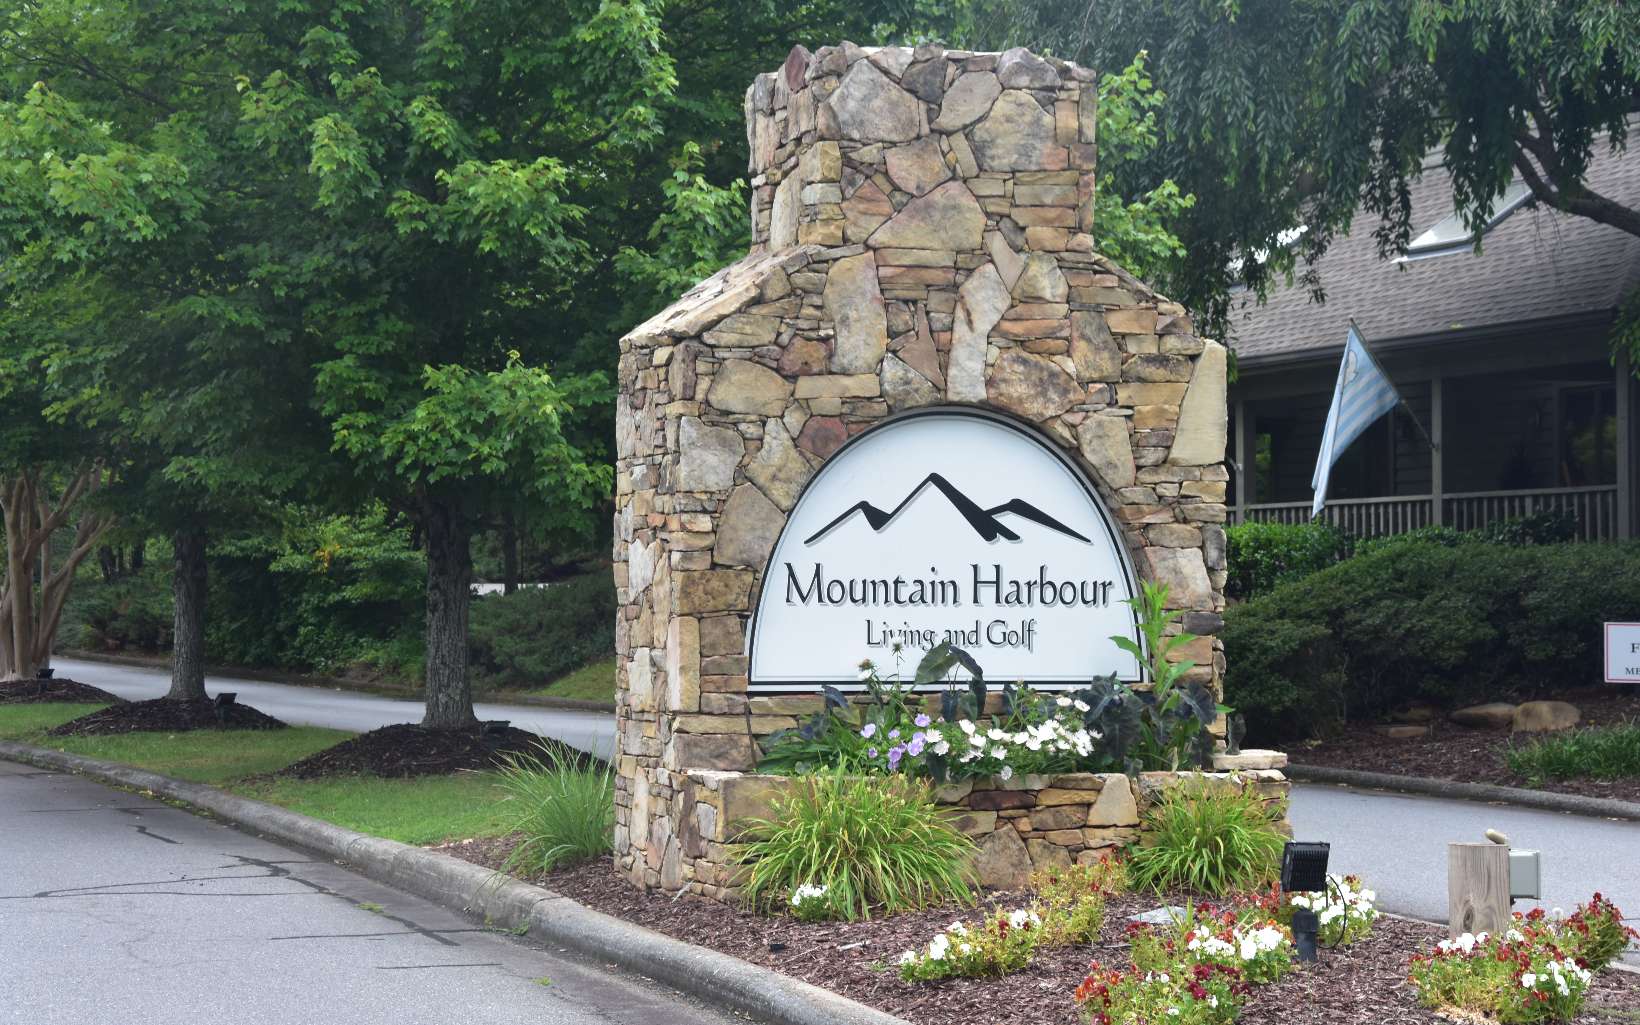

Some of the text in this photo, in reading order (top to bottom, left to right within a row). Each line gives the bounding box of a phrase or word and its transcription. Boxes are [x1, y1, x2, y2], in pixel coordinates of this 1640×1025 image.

[784, 562, 1113, 606] Mountain Harbour
[865, 618, 1037, 652] Living and Golf
